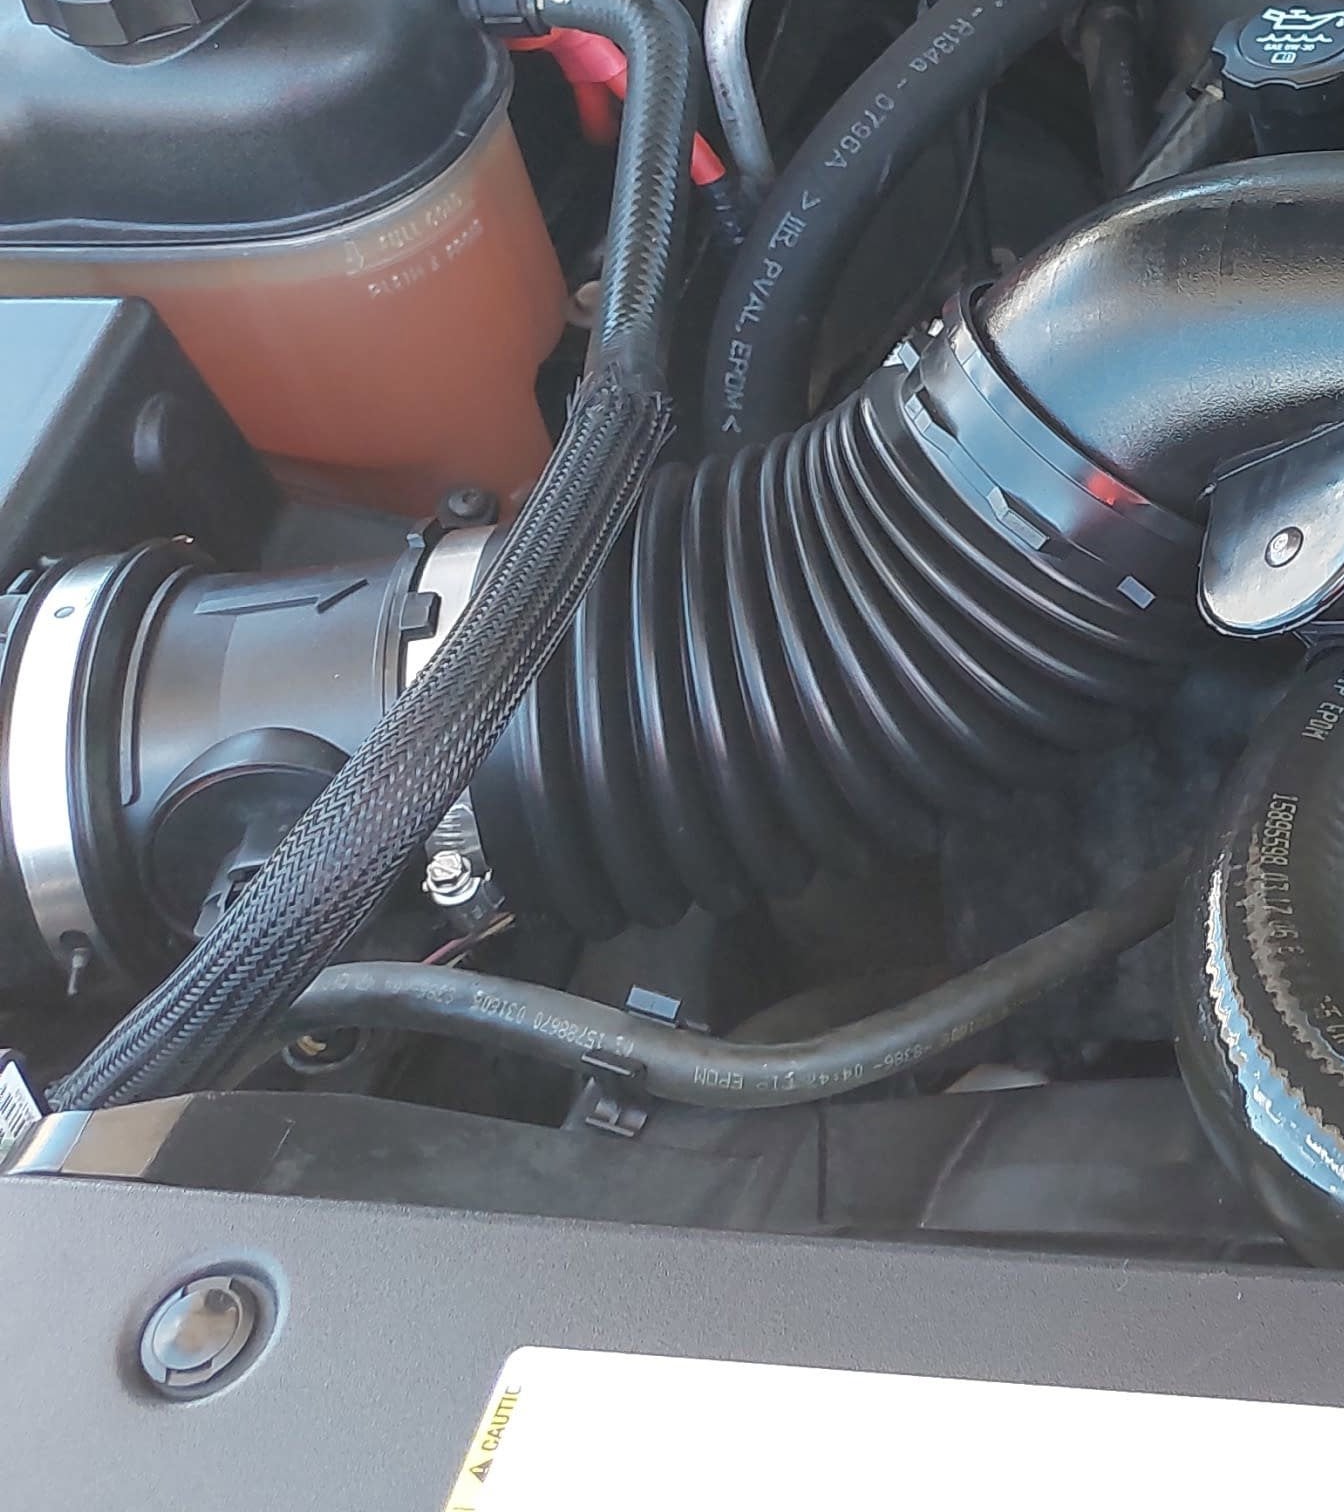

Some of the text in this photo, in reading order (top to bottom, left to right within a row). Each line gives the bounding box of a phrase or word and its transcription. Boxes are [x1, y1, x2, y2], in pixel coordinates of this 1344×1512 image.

[908, 16, 975, 73] R134a
[824, 92, 895, 169] 0796A
[1301, 701, 1344, 741] EPDM
[1262, 792, 1300, 867] 15895598
[531, 1010, 607, 1050] 15788670
[689, 1059, 745, 1096] EPDM
